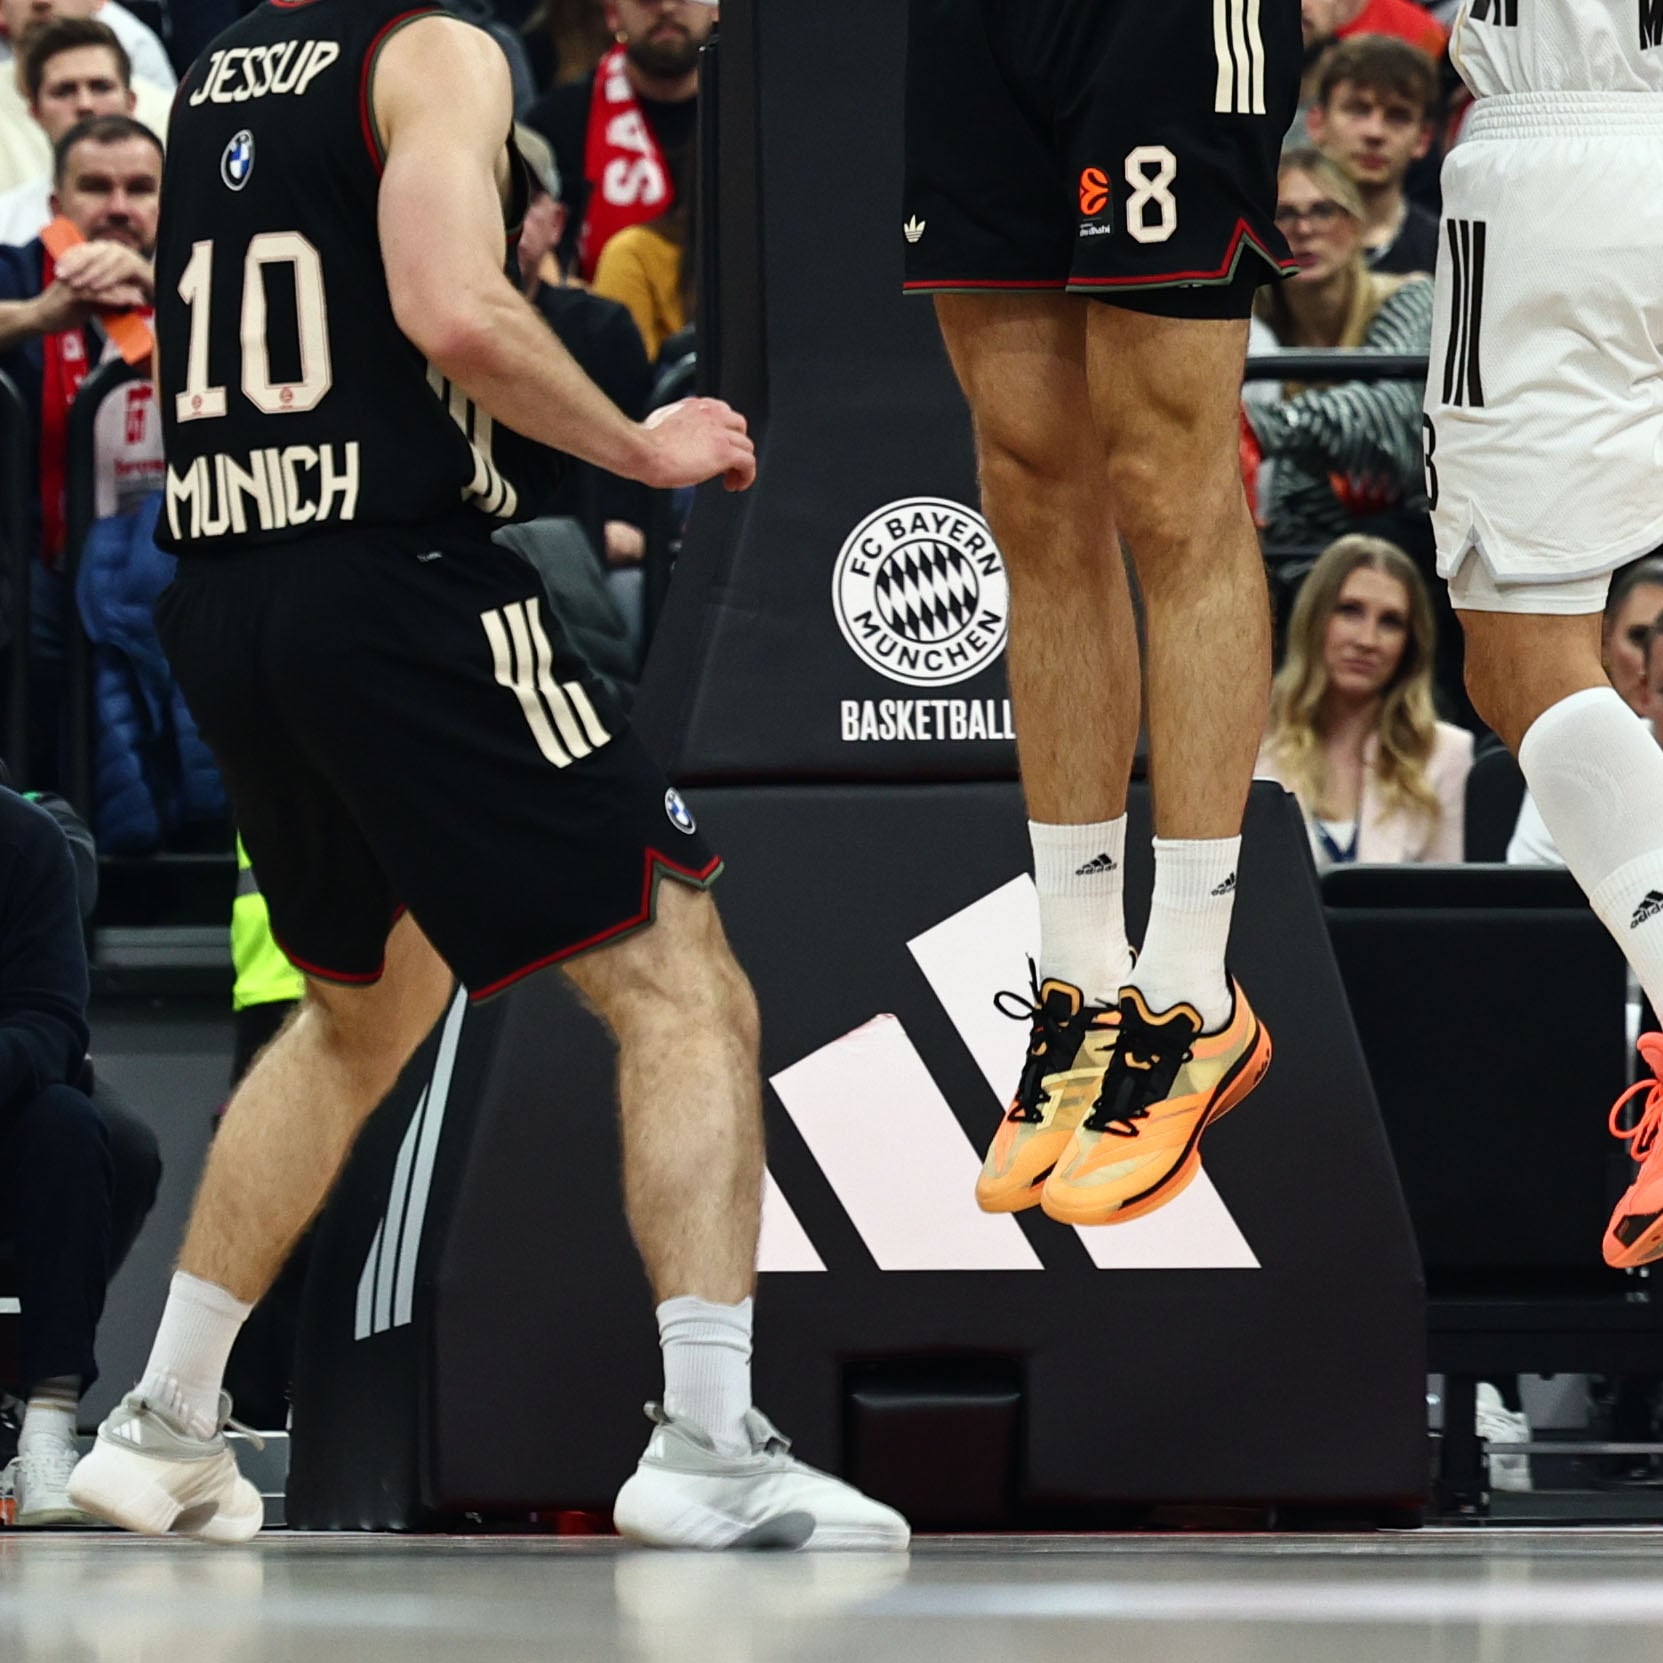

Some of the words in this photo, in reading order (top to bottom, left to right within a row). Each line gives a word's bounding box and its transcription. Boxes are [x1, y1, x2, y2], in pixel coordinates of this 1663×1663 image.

[189, 39, 340, 108] JESSUP
[1124, 145, 1177, 244] 8
[175, 230, 334, 424] 10
[165, 441, 360, 540] MUNICH
[849, 537, 883, 578] FC
[885, 511, 1002, 577] BAYERN
[840, 698, 1017, 742] BASKETBALL
[1075, 862, 1118, 876] adidas
